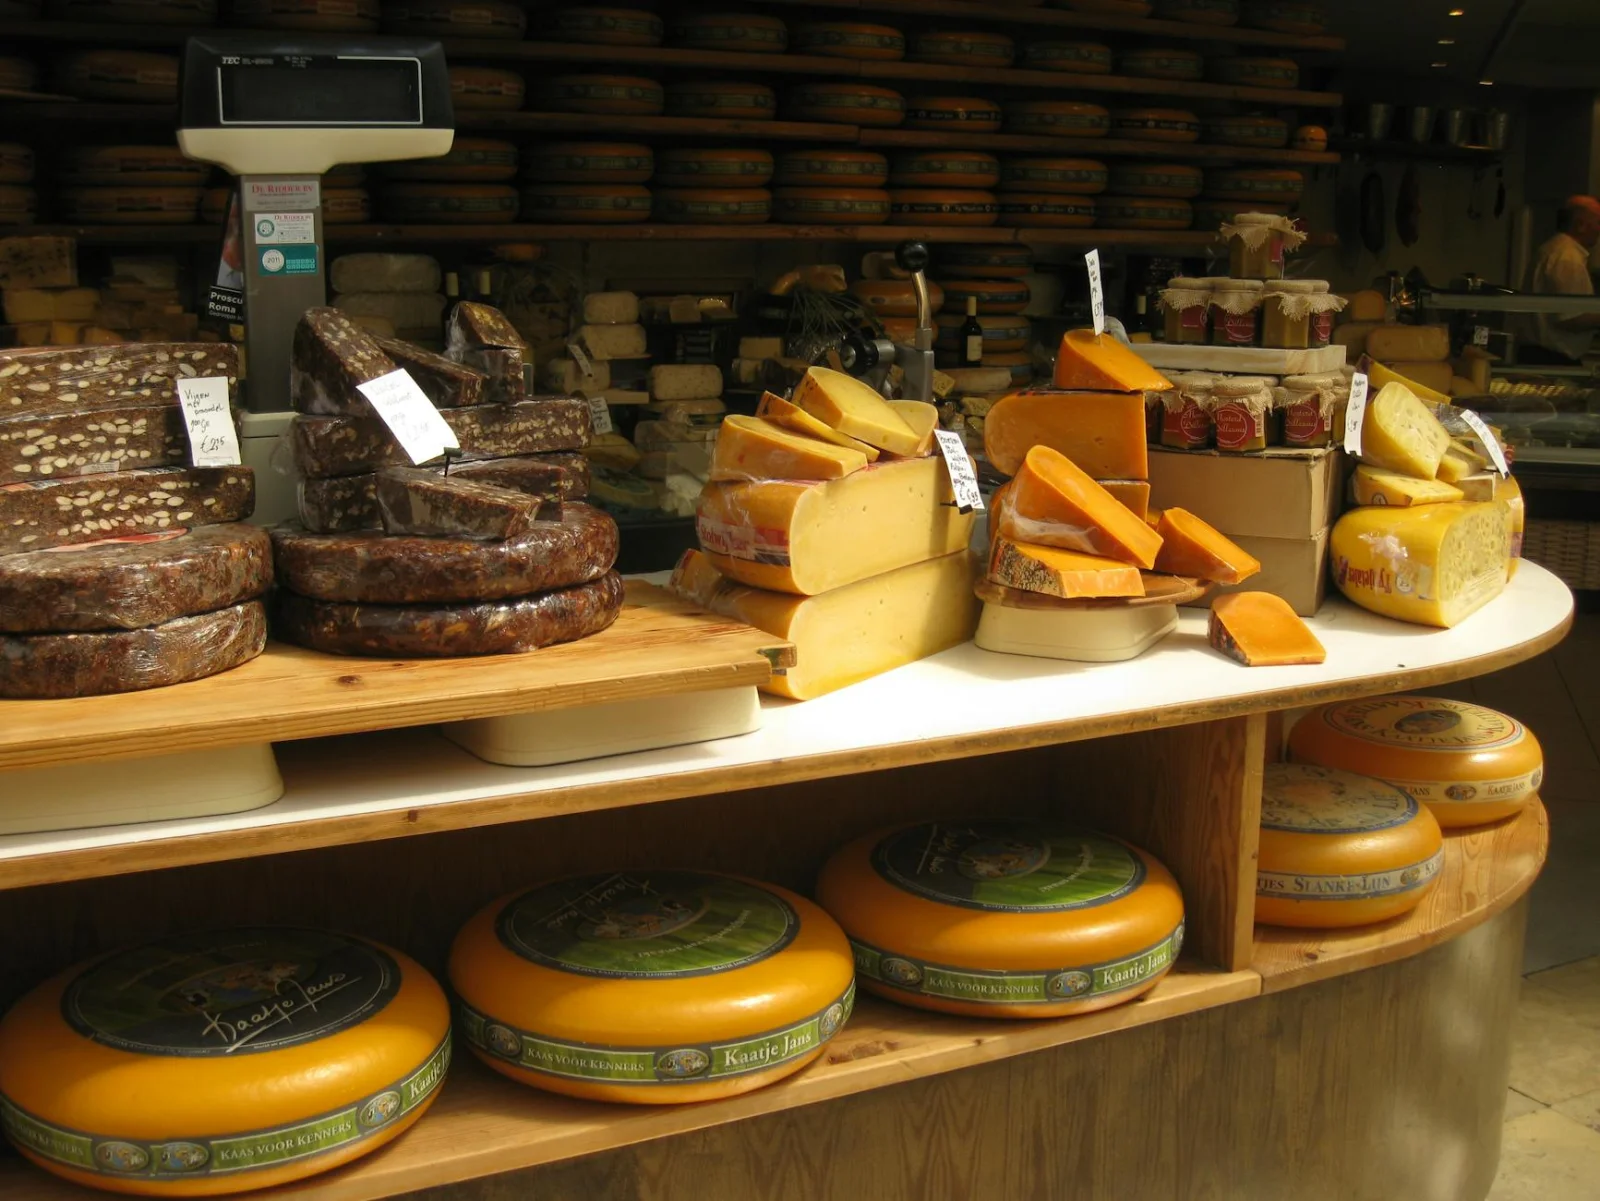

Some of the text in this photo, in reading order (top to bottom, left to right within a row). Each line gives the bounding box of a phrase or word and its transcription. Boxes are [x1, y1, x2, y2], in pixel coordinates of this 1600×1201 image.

[222, 56, 240, 64] TEC
[209, 302, 236, 314] Roma
[1103, 951, 1167, 985] Kaatje Jans
[929, 976, 1040, 995] KAAS VOOR KENNERS
[528, 1048, 645, 1072] KAAS VOOR KENNERS
[724, 1042, 779, 1066] Kaatje
[781, 1032, 812, 1057] Jans
[410, 1061, 441, 1099] Kaatje
[220, 1120, 353, 1160] KAAS VOOR KENNERS
